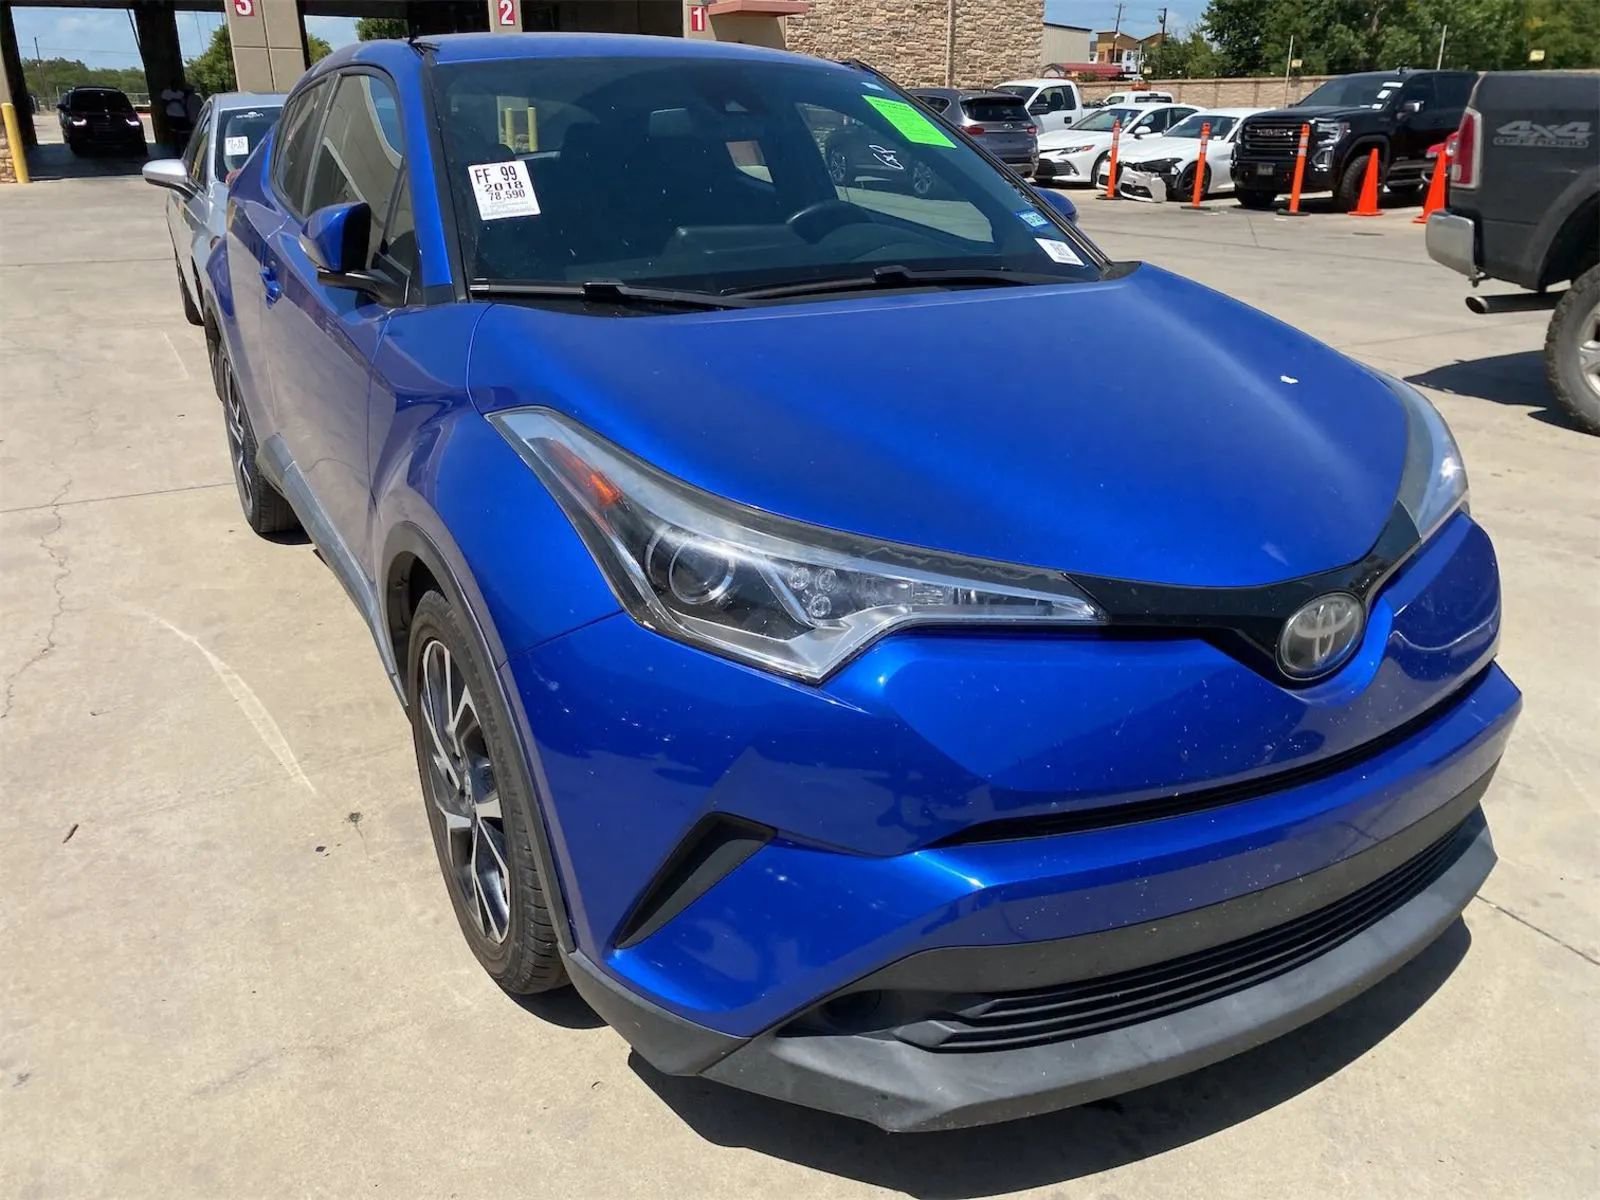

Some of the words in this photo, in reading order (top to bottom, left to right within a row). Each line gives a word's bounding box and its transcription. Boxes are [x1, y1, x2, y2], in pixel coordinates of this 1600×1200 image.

[500, 0, 514, 25] 2
[692, 7, 703, 31] 1
[474, 168, 491, 184] FF
[500, 165, 518, 181] 99
[484, 181, 523, 192] 2018
[488, 189, 526, 201] 78,590
